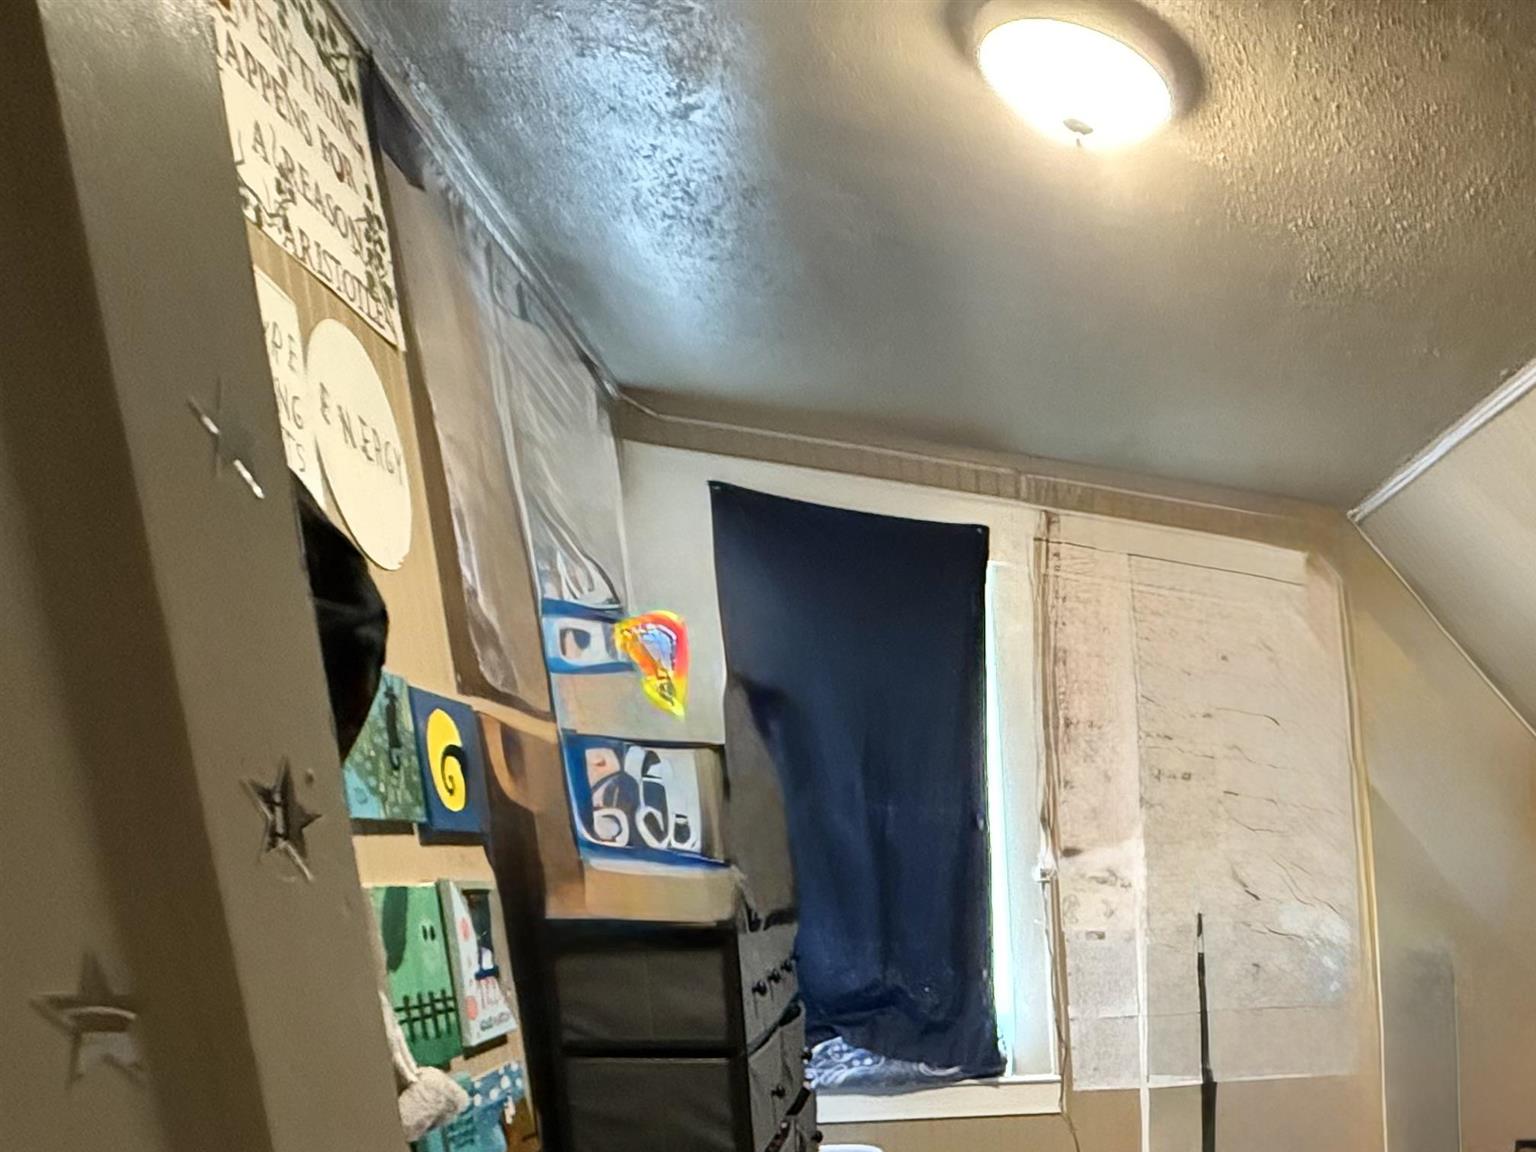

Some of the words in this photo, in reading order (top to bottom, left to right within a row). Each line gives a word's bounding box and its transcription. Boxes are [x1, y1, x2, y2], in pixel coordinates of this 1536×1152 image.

[251, 119, 272, 166] A
[278, 144, 368, 265] REASON
[317, 124, 360, 196] FOR
[319, 381, 405, 486] ENERGY
